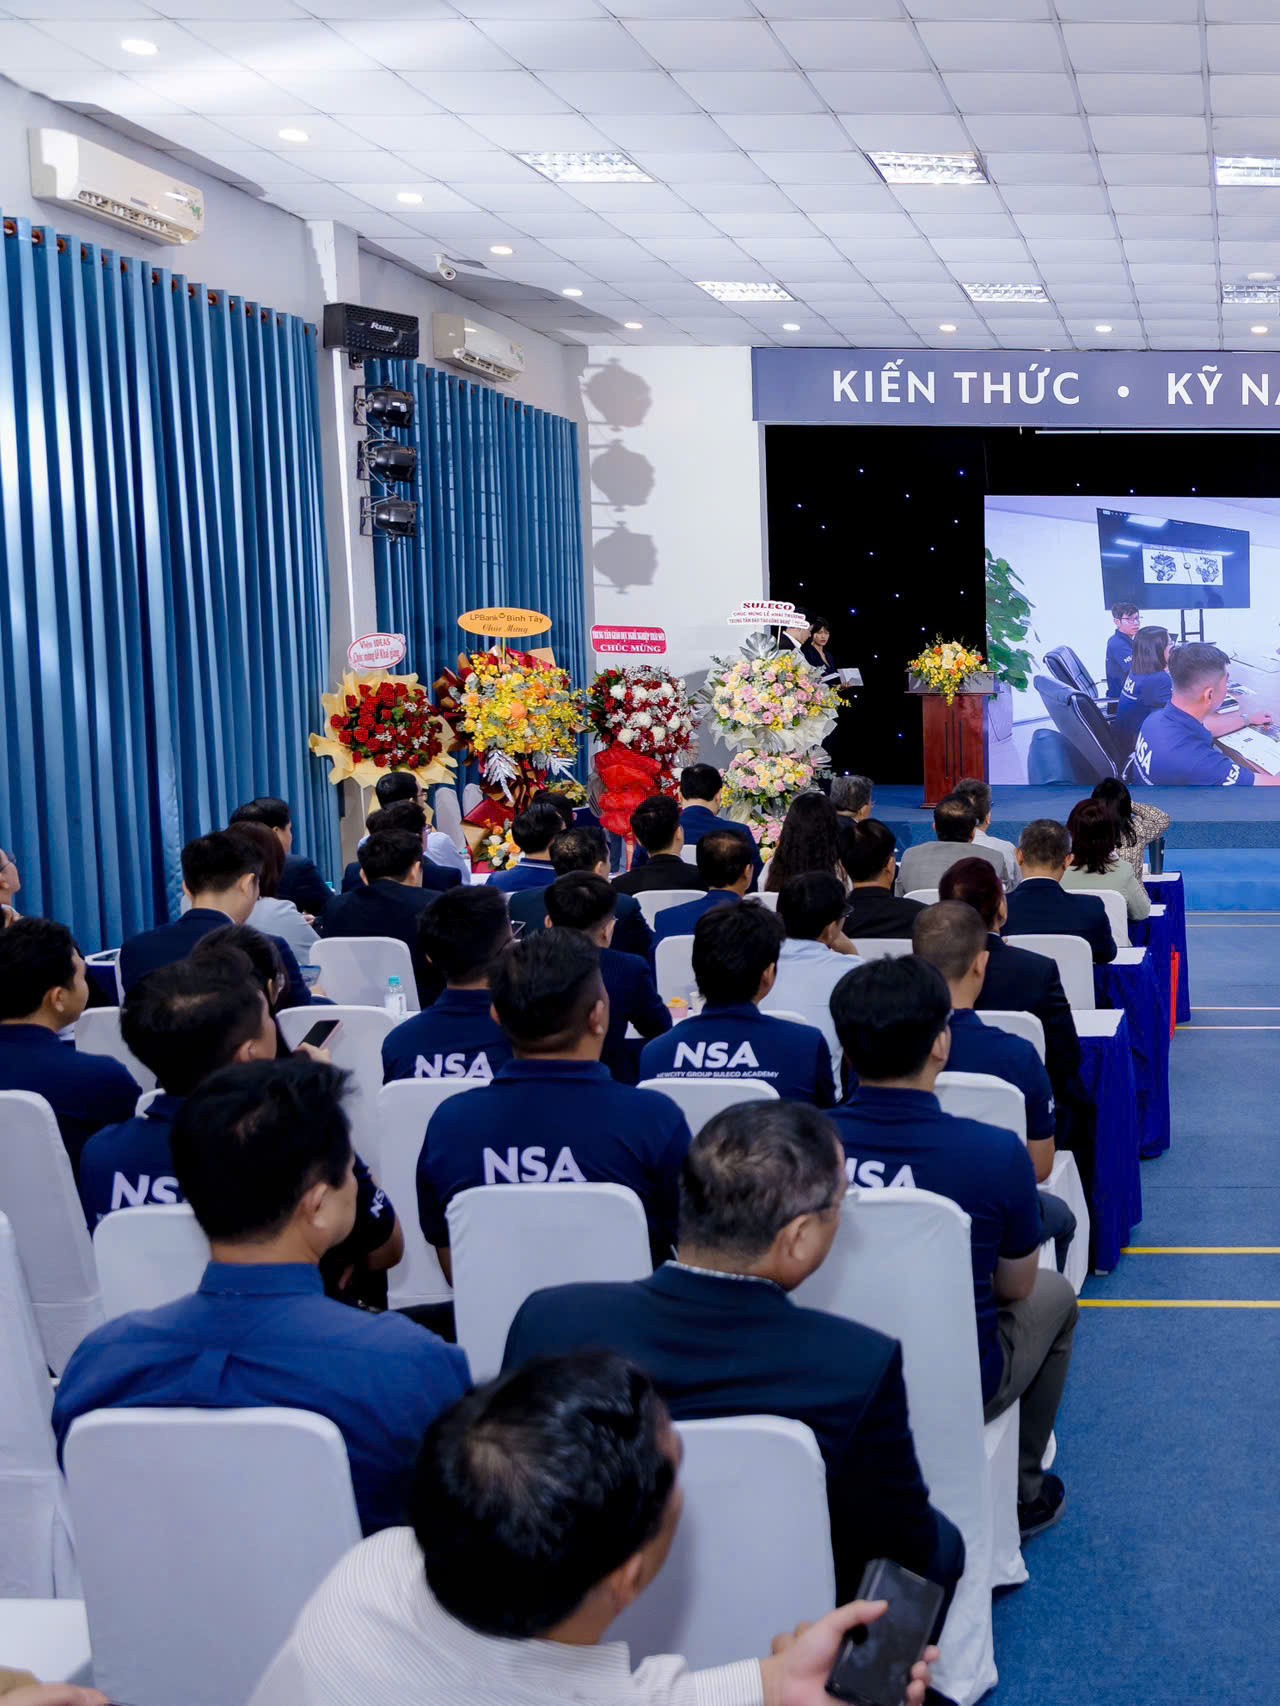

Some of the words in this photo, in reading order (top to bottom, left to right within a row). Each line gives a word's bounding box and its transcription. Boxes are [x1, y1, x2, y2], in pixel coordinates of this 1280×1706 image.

[832, 358, 936, 404] KIẾN
[953, 362, 1081, 405] THỨC
[1167, 365, 1226, 405] KỸ
[470, 613, 498, 621] LPBank
[742, 602, 793, 611] SULECO
[600, 642, 629, 652] CHÚC
[414, 1051, 494, 1079] NSA
[673, 1041, 760, 1069] NSA
[742, 1071, 779, 1079] ACADEMY
[483, 1146, 587, 1184] NSA
[110, 1171, 187, 1210] NS
